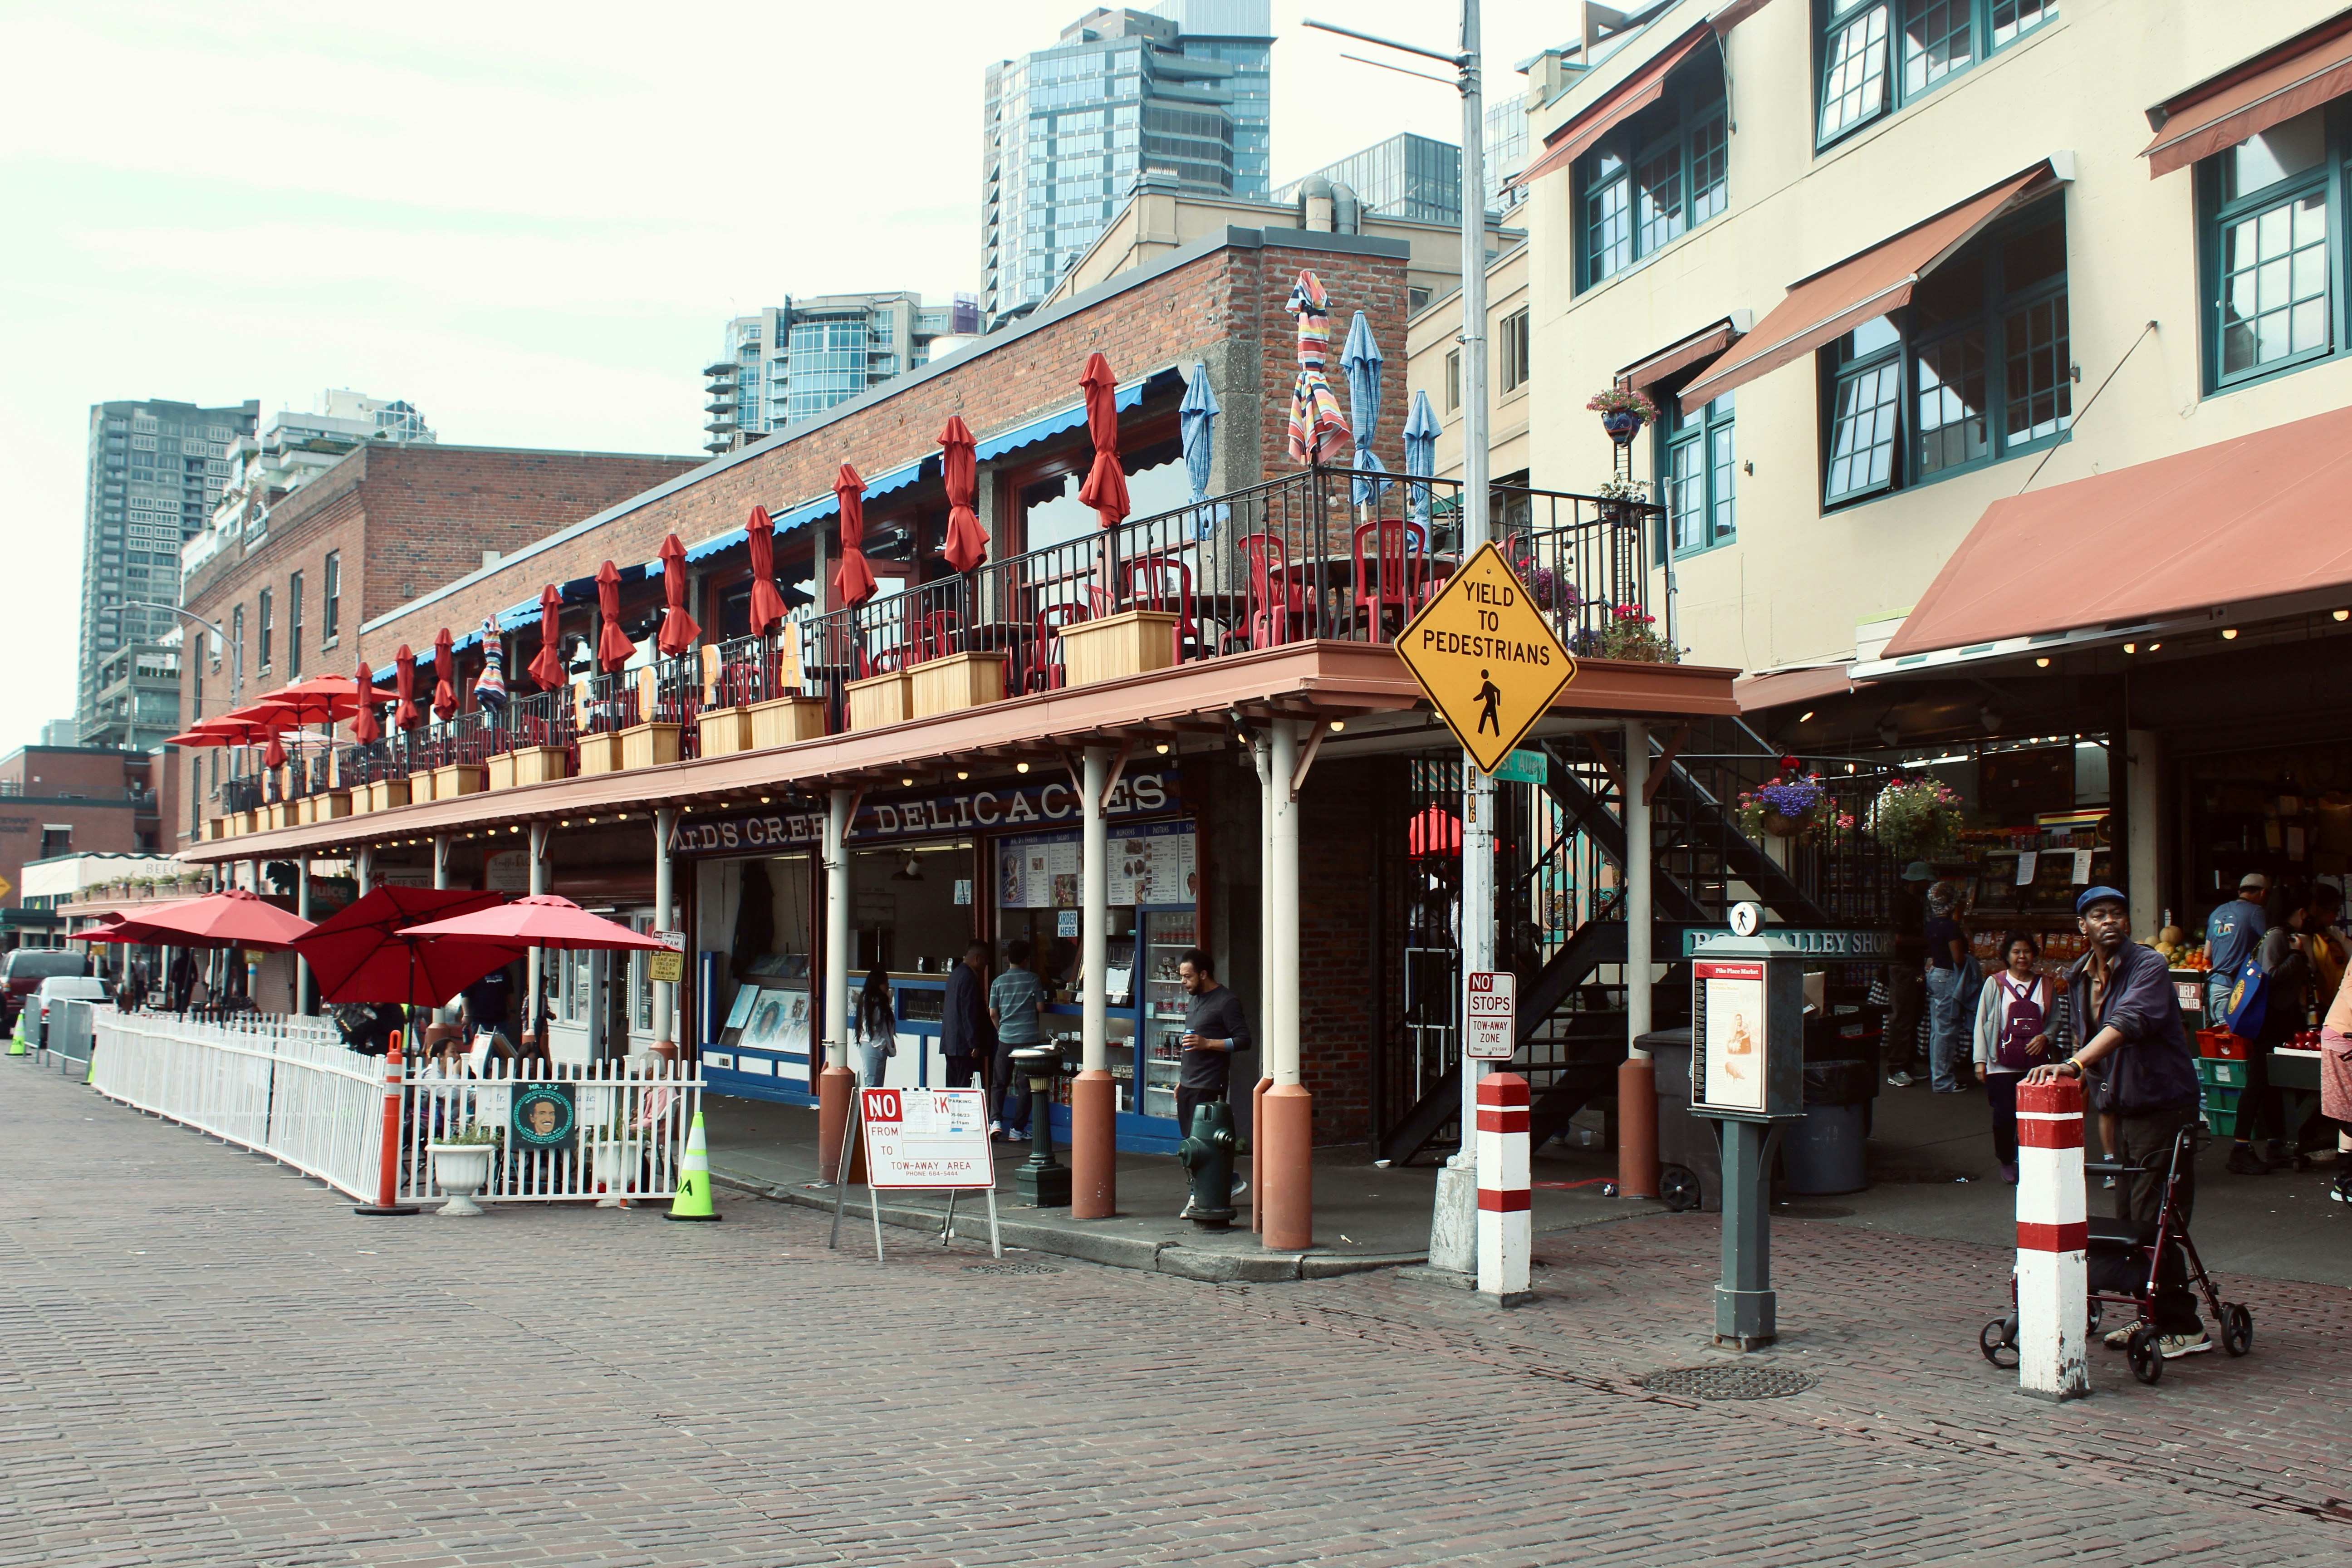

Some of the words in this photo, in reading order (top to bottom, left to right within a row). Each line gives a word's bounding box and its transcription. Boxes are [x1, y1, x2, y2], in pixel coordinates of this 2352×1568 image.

[1463, 581, 1514, 607] YIELD
[1478, 610, 1499, 632] TO
[1423, 629, 1550, 666] PEDESTRIANS
[575, 622, 805, 731] COPA
[1518, 753, 1544, 780] Alley
[747, 813, 859, 844] GREE
[873, 774, 1167, 833] DELICACES
[1153, 826, 1169, 834] PASTRIES
[1186, 823, 1196, 833] SIDE
[146, 863, 177, 874] BEEC
[1058, 913, 1077, 925] ORDER
[1060, 926, 1075, 936] HERE
[1473, 975, 1490, 990] NO
[2179, 985, 2195, 998] HELP
[1472, 996, 1510, 1010] STOPS
[1473, 1021, 1508, 1030] TOW-AWAY
[1480, 1034, 1500, 1043] ZONE
[868, 1094, 896, 1117] NO
[872, 1127, 898, 1136] FROM
[881, 1146, 893, 1155] TO
[891, 1162, 939, 1170] TOW-AWAY
